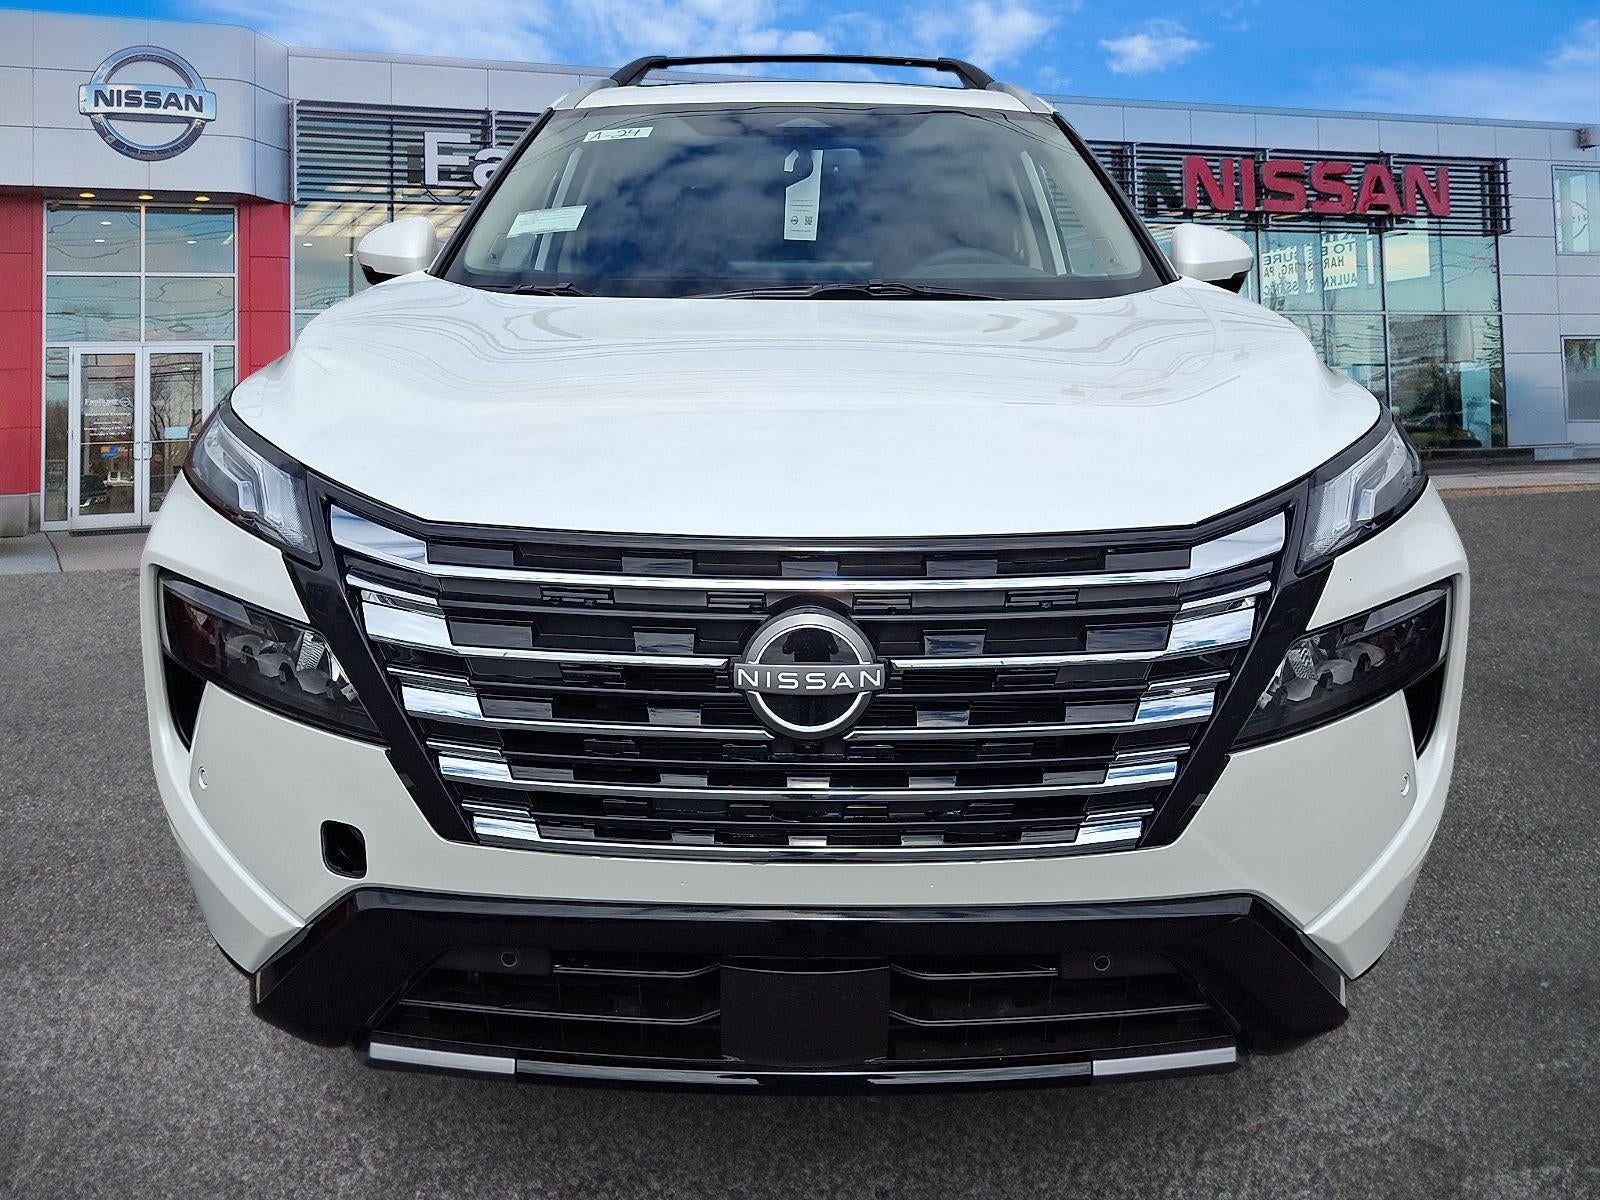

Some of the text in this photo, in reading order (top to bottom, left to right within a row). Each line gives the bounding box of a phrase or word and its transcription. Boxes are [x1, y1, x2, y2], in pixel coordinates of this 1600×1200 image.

[93, 89, 204, 113] NISSAN
[1182, 155, 1451, 217] NISSAN
[736, 668, 881, 690] NISSAN
